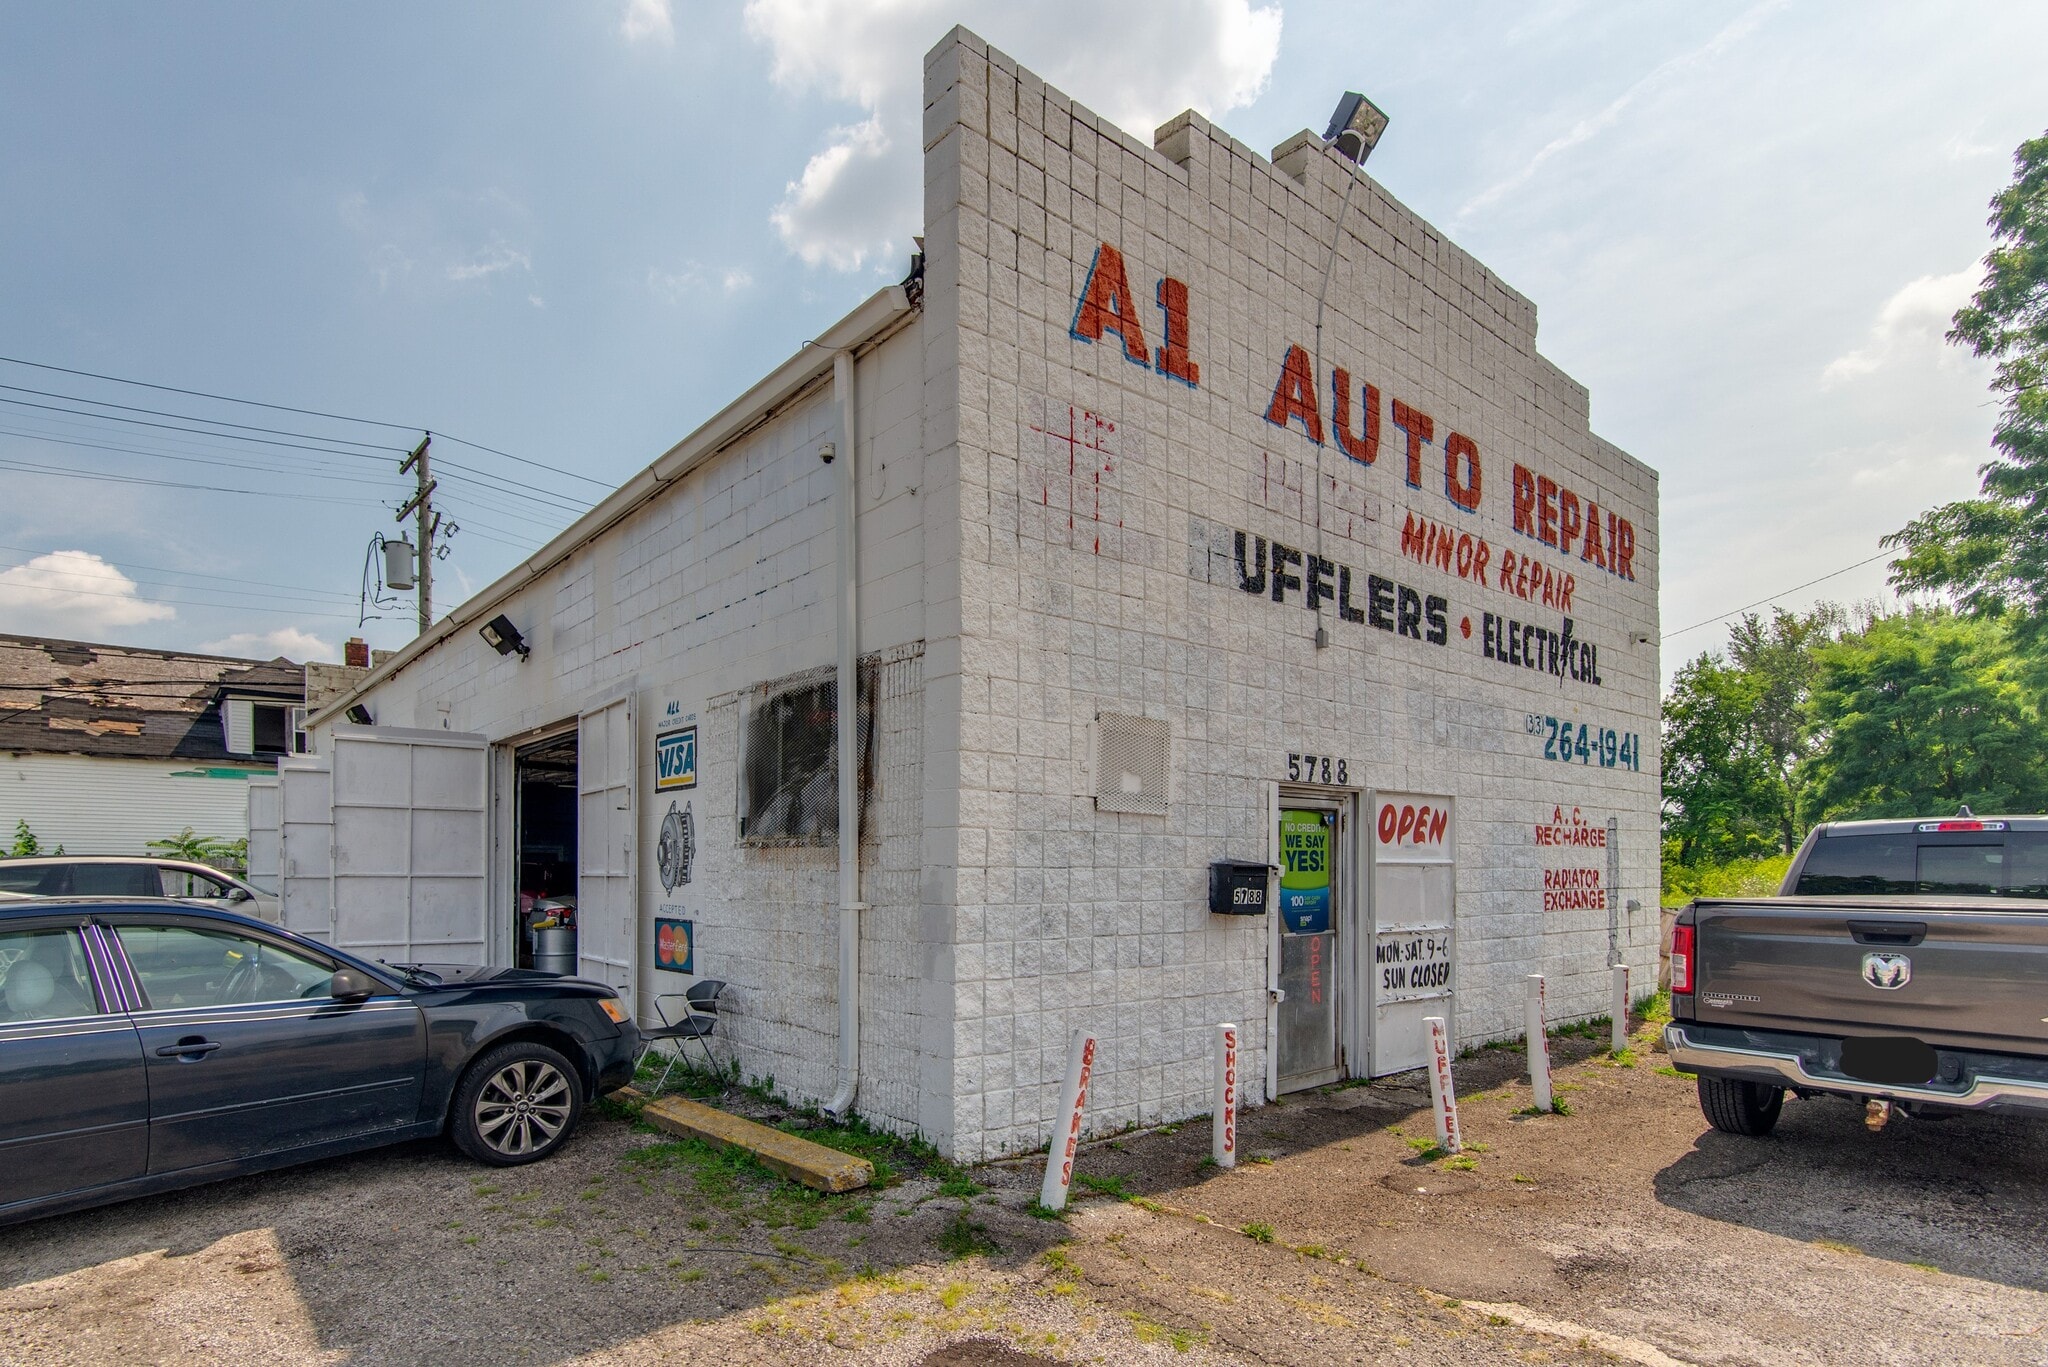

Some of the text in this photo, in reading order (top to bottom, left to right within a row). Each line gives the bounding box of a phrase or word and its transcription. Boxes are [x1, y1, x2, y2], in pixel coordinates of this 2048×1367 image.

[1069, 243, 1636, 582] A1 AUTO REPAIR
[1401, 511, 1575, 613] MINOR REPAIR
[1483, 613, 1601, 689] ELECTRICAL
[666, 701, 680, 716] ALL
[1544, 715, 1639, 772] 264-1941
[657, 742, 694, 778] VISA
[1289, 753, 1348, 784] 5788
[1285, 823, 1296, 832] NO
[1378, 804, 1447, 846] OPEN
[1535, 825, 1606, 847] RECHARGE
[1285, 835, 1325, 848] WE SAY
[1285, 850, 1325, 872] YES!
[1544, 868, 1599, 889] RADIATOR
[659, 904, 686, 915] ACCEPTED
[1234, 888, 1261, 904] 5788
[1291, 895, 1304, 907] 100
[1544, 889, 1605, 912] EXCHANGE
[1311, 935, 1321, 1006] OPEN
[1383, 961, 1450, 990] SUN CLOSED
[1224, 1030, 1236, 1152] SHOCKS
[1062, 1037, 1096, 1186] BRAKES
